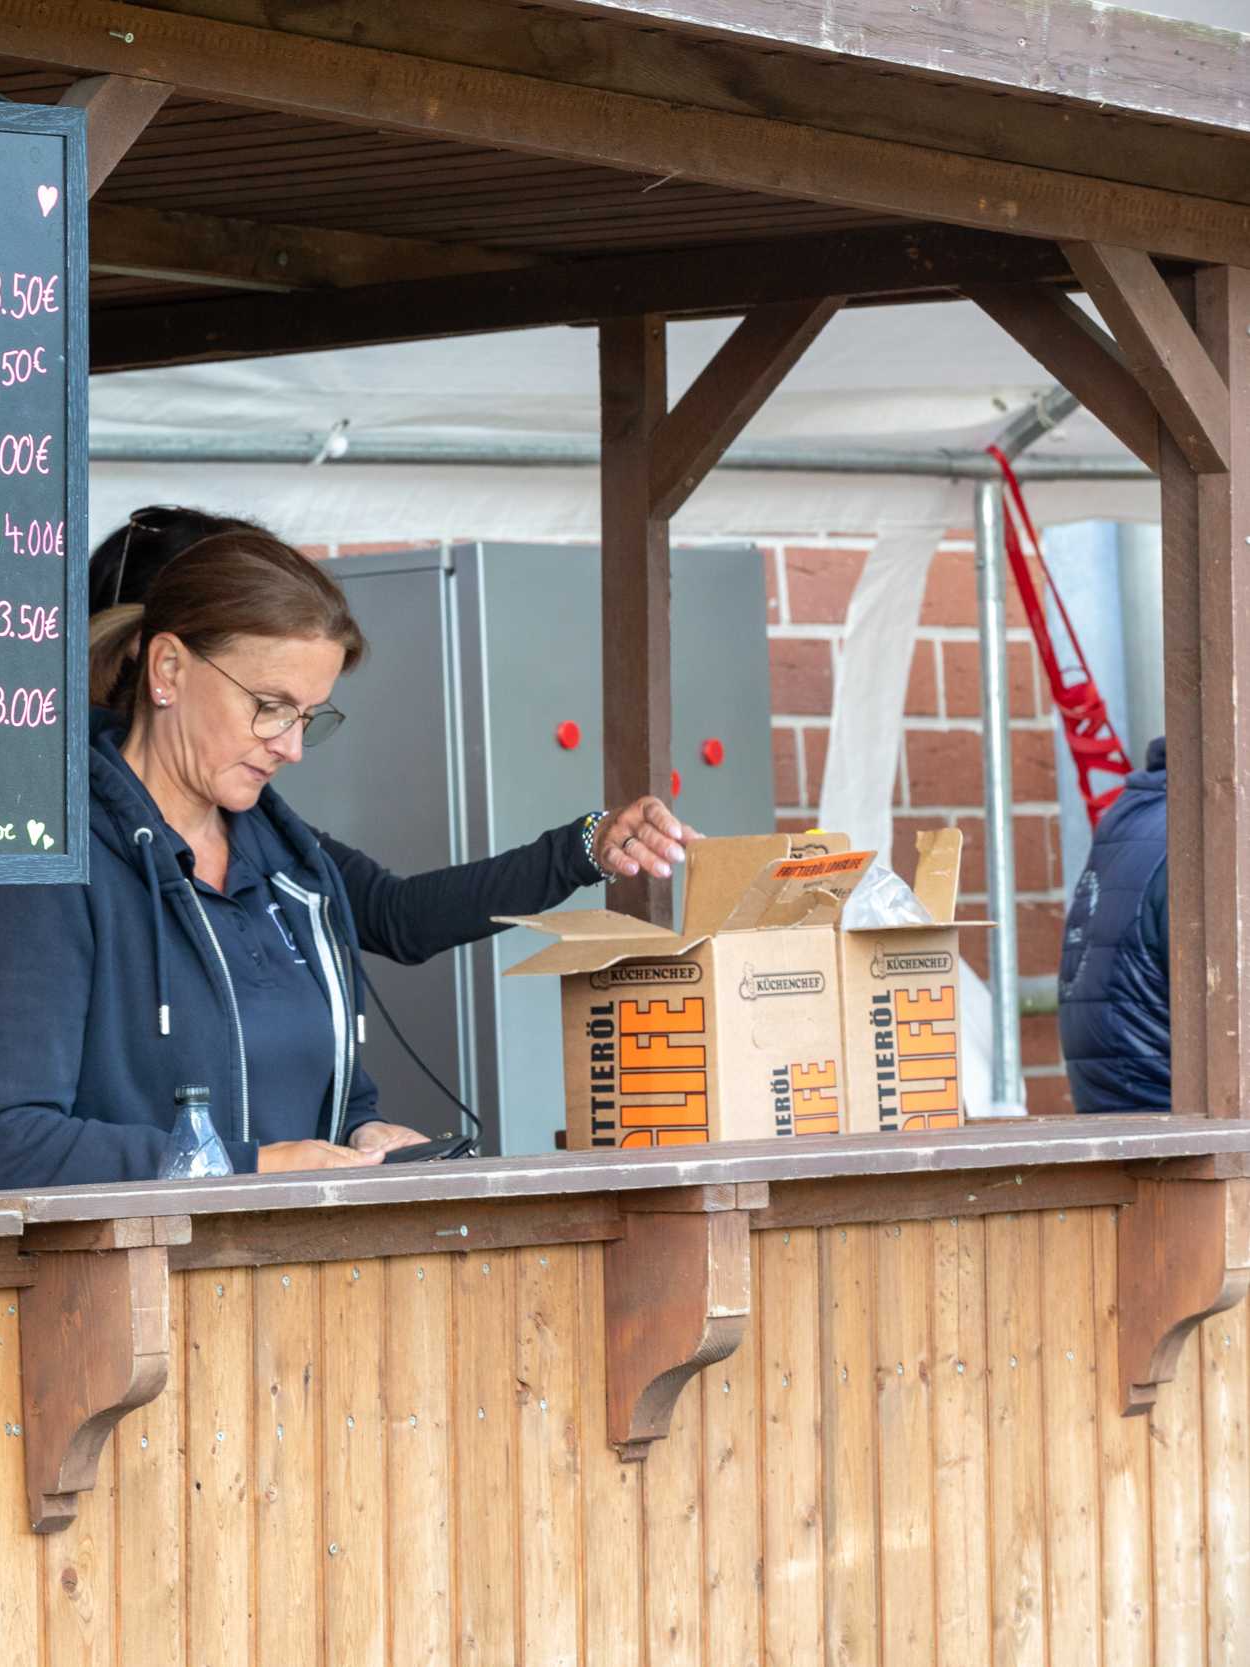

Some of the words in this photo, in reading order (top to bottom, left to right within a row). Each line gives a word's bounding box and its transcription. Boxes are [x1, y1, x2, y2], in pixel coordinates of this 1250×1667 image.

[5, 512, 65, 556] 4.00€
[886, 956, 950, 971] KÜCHENCHEF
[610, 967, 696, 982] KÜCHENCHEF
[756, 976, 822, 992] KÜCHENCHEF
